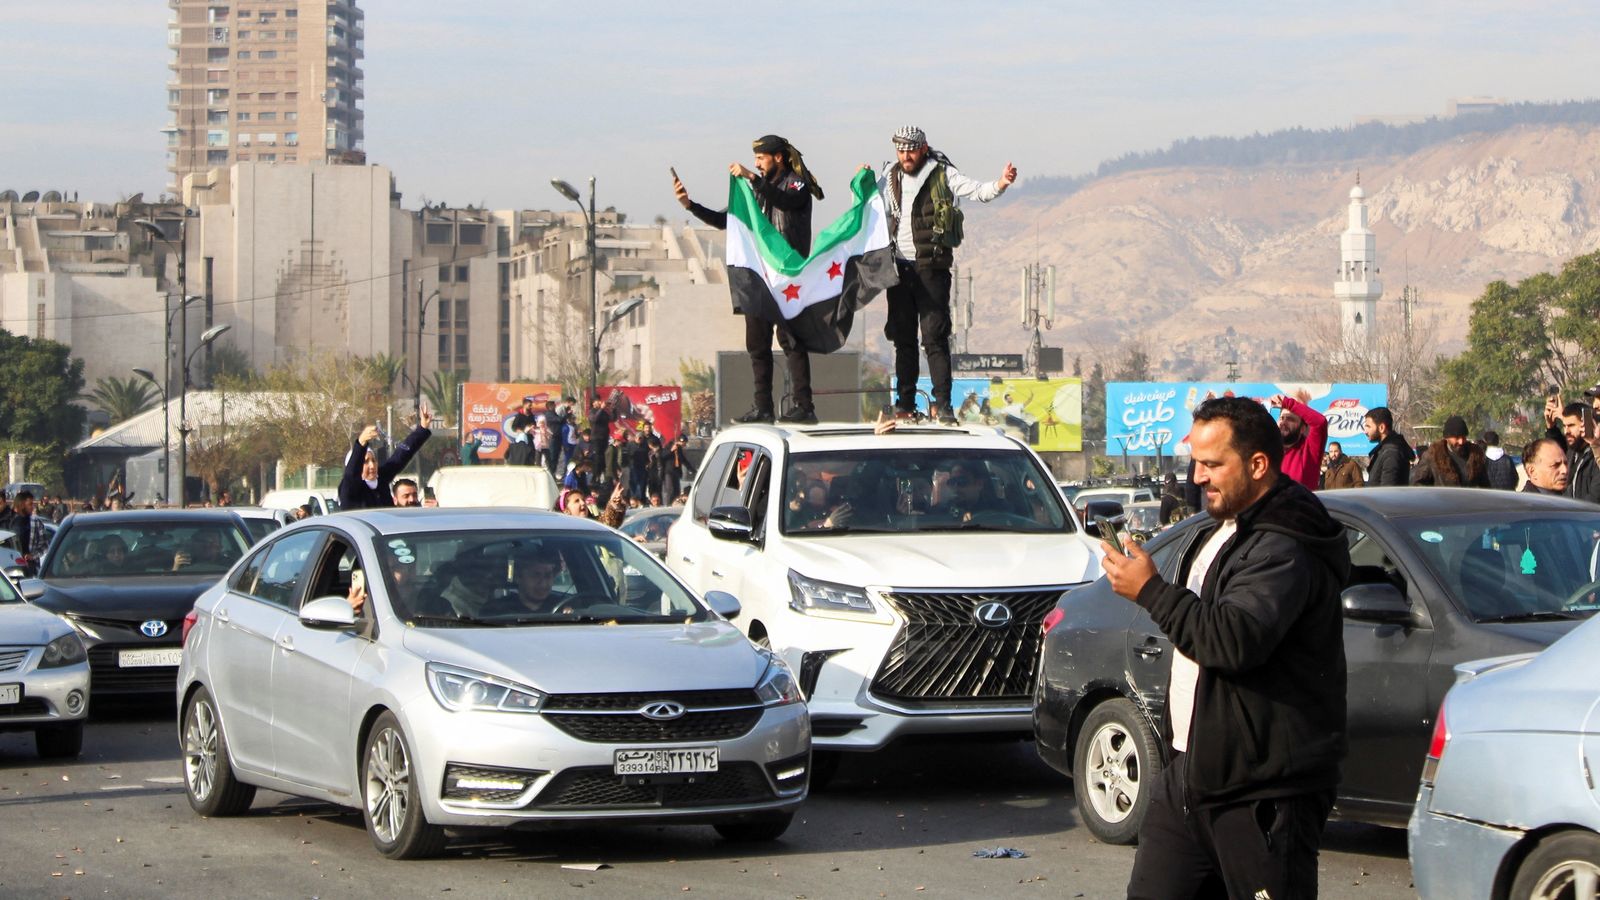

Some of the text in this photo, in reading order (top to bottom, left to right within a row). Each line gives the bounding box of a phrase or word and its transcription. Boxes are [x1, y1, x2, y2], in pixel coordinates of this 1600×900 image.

[671, 392, 678, 401] لا
[472, 404, 499, 415] رفيقة
[1343, 410, 1359, 418] New
[467, 412, 502, 425] المدرسة
[1122, 401, 1175, 430] طيب
[1325, 413, 1365, 431] Park
[618, 751, 654, 763] دمشق
[619, 762, 655, 772] 339314
